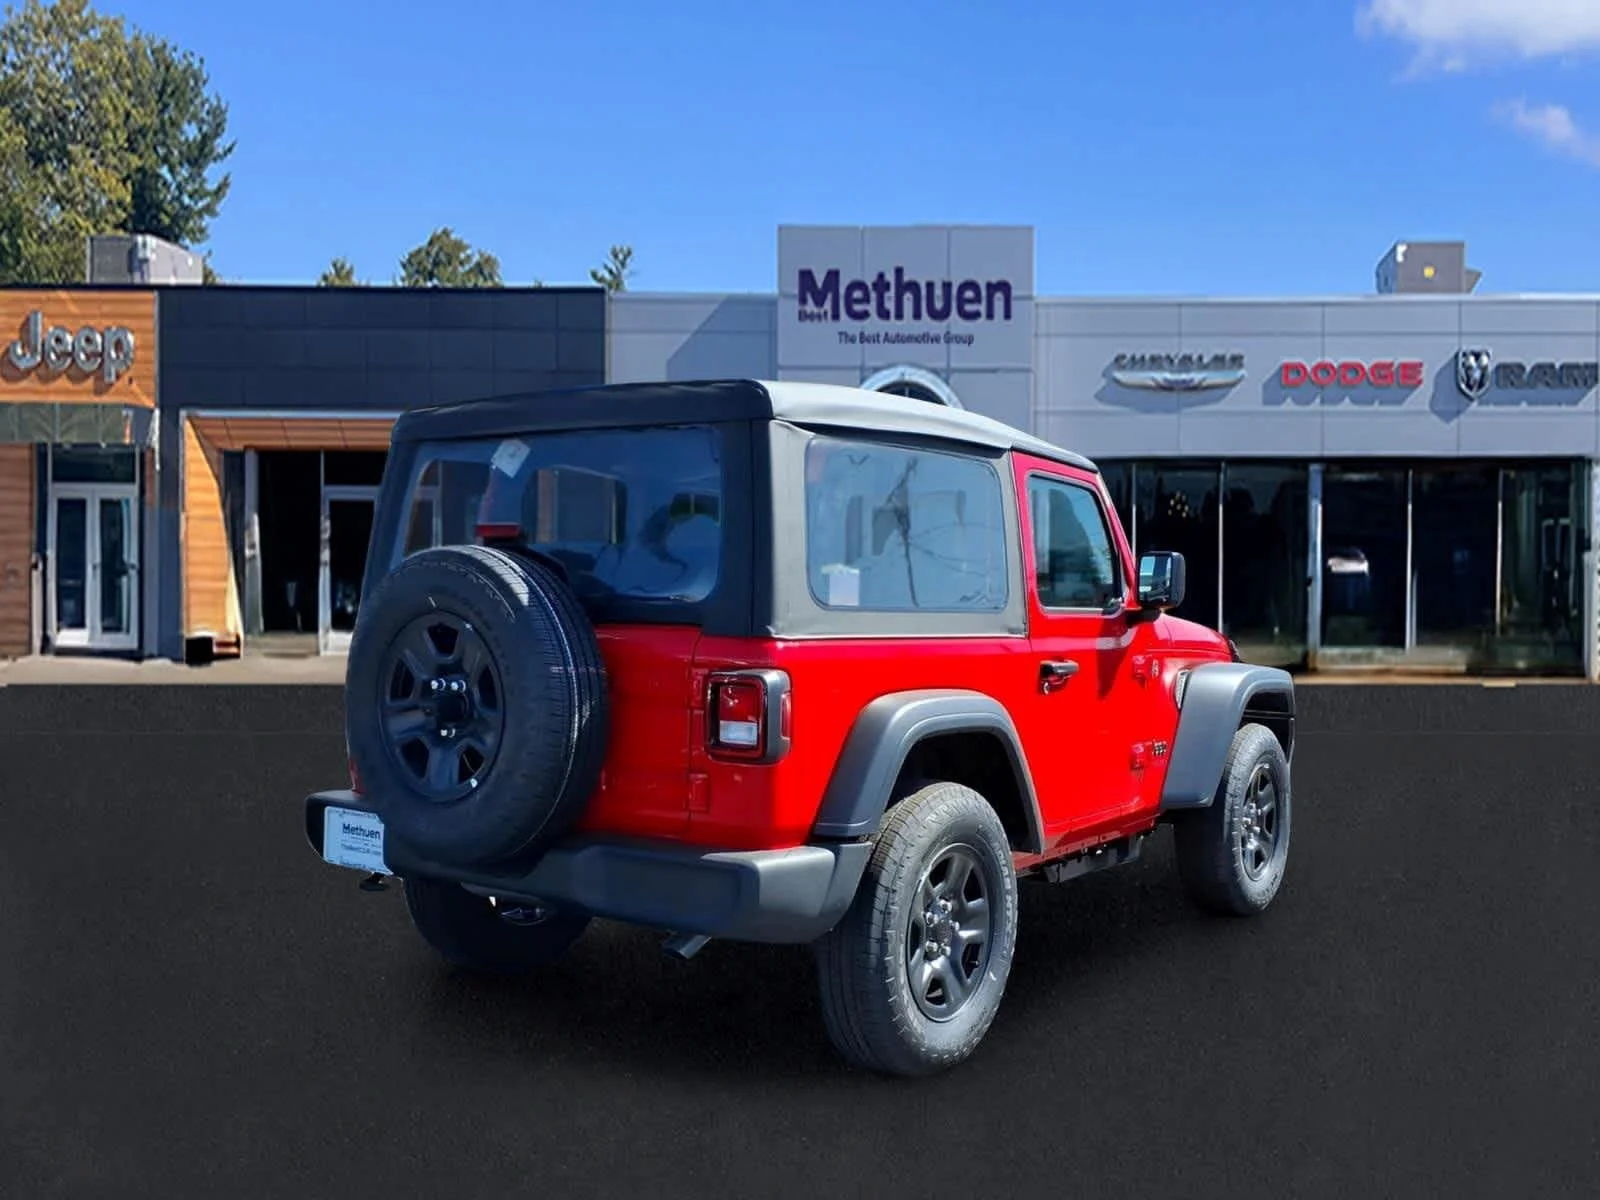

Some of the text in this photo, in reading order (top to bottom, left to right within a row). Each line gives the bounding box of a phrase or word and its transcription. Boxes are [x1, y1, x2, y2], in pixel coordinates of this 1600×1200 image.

[798, 266, 1012, 321] Methuen
[10, 311, 134, 383] Jeep
[838, 332, 974, 346] The Best Automotive Group
[1114, 353, 1244, 371] CHRYSLER
[1282, 361, 1423, 386] DODGE
[1495, 362, 1598, 389] RAM
[342, 823, 380, 839] Methuen
